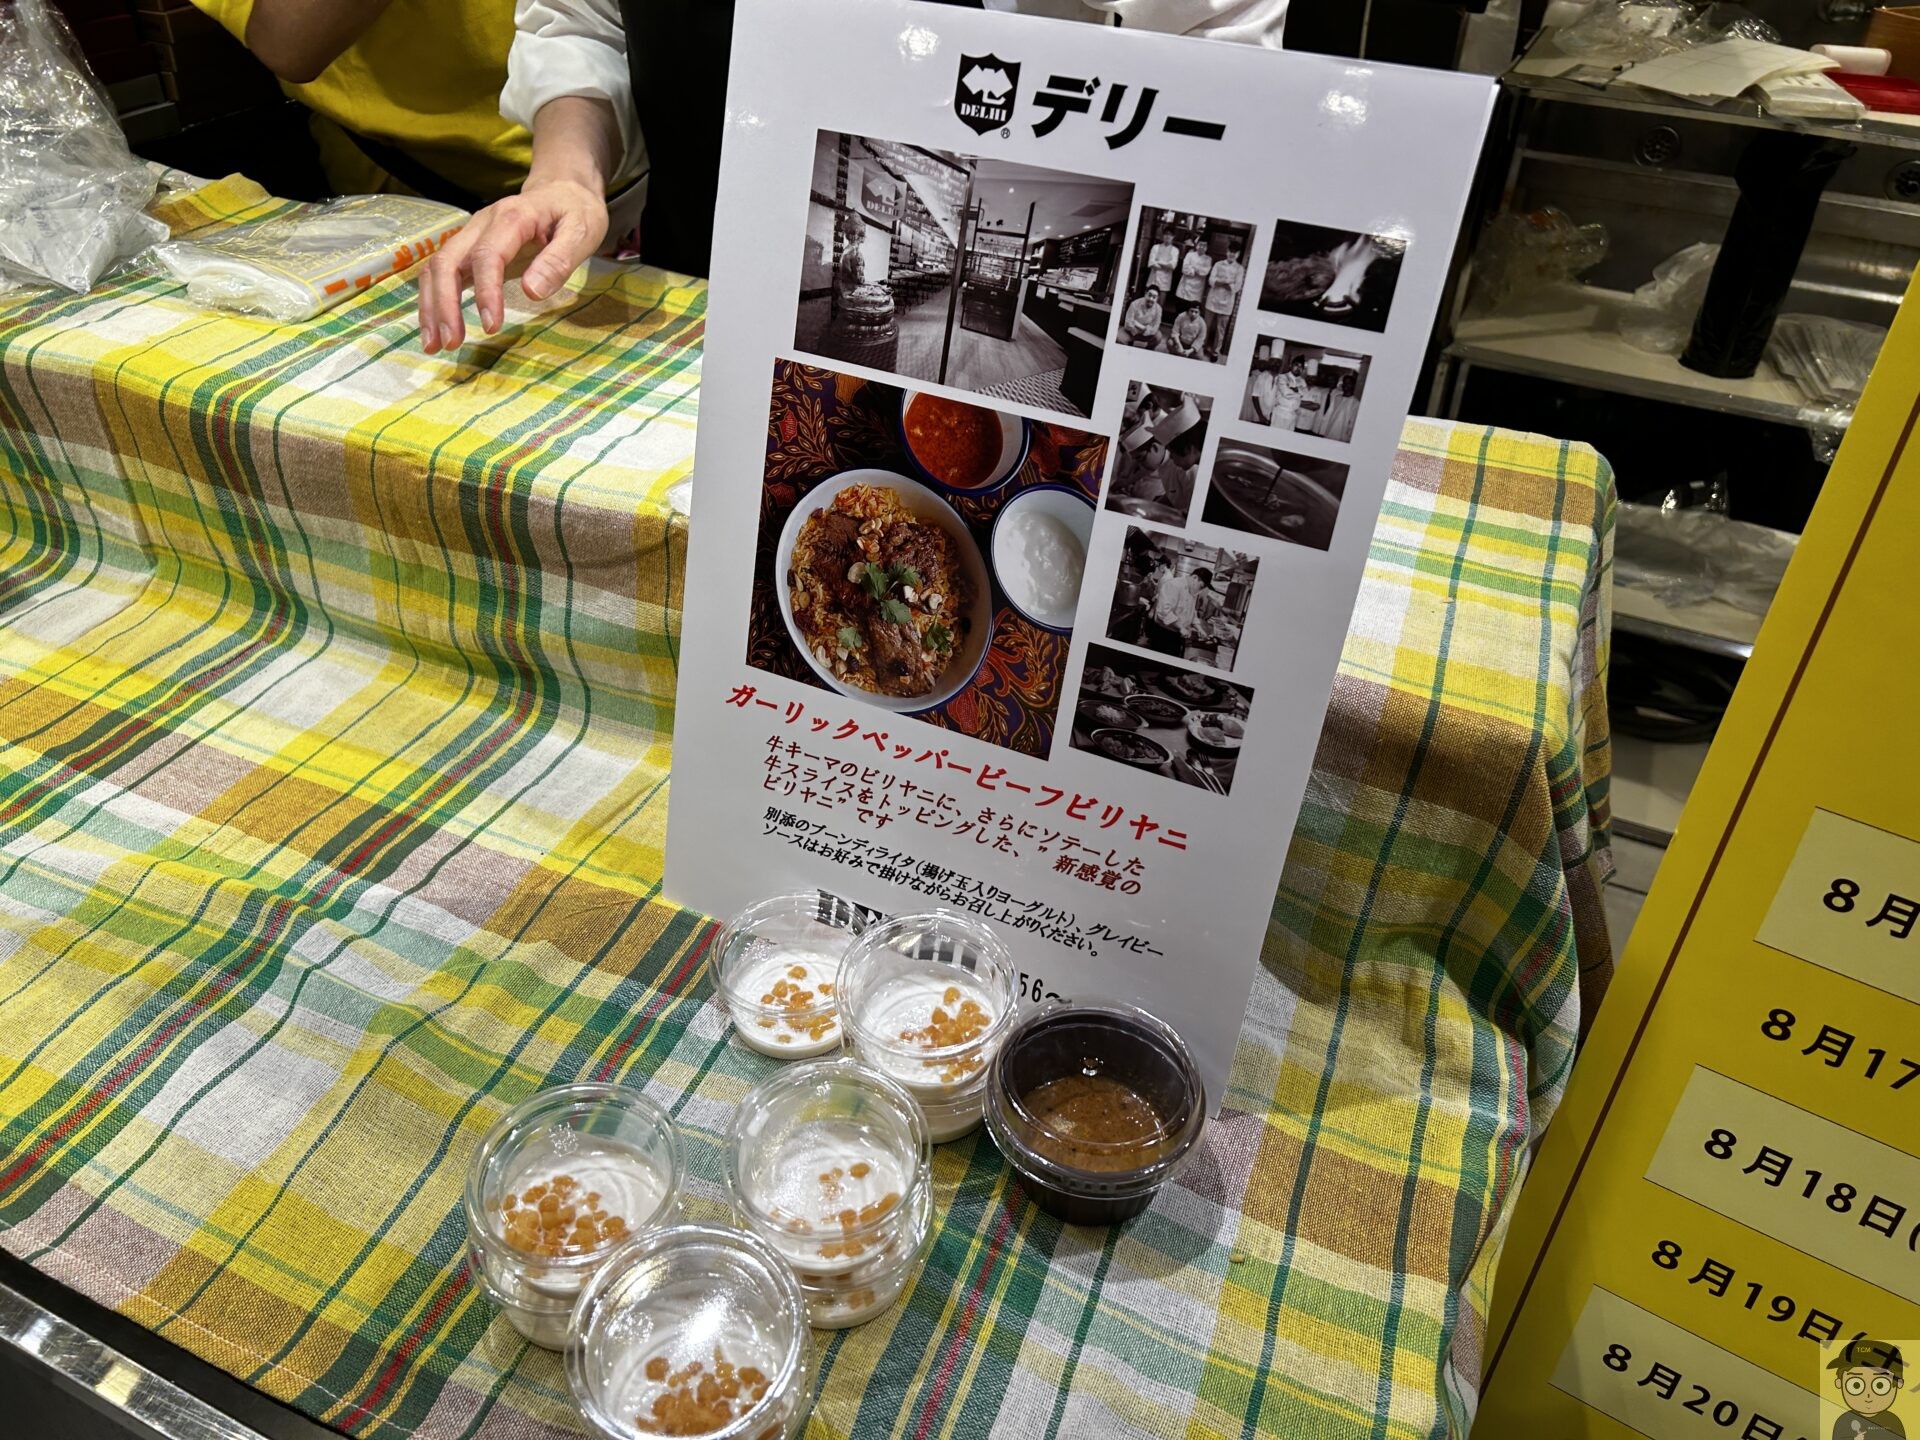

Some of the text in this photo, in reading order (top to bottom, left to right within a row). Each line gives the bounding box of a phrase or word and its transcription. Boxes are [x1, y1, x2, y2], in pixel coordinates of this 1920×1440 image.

[960, 102, 1007, 122] DELHI
[1030, 75, 1227, 151] デリー
[725, 684, 1188, 850] ガーリックペッパービーフビリヤニ
[762, 822, 1098, 958] ソースはお好みで掛けながらお召し上がりください。
[1822, 877, 1920, 939] 8月
[1760, 1007, 1920, 1090] 8月17
[1601, 1343, 1808, 1440] 8月20日
